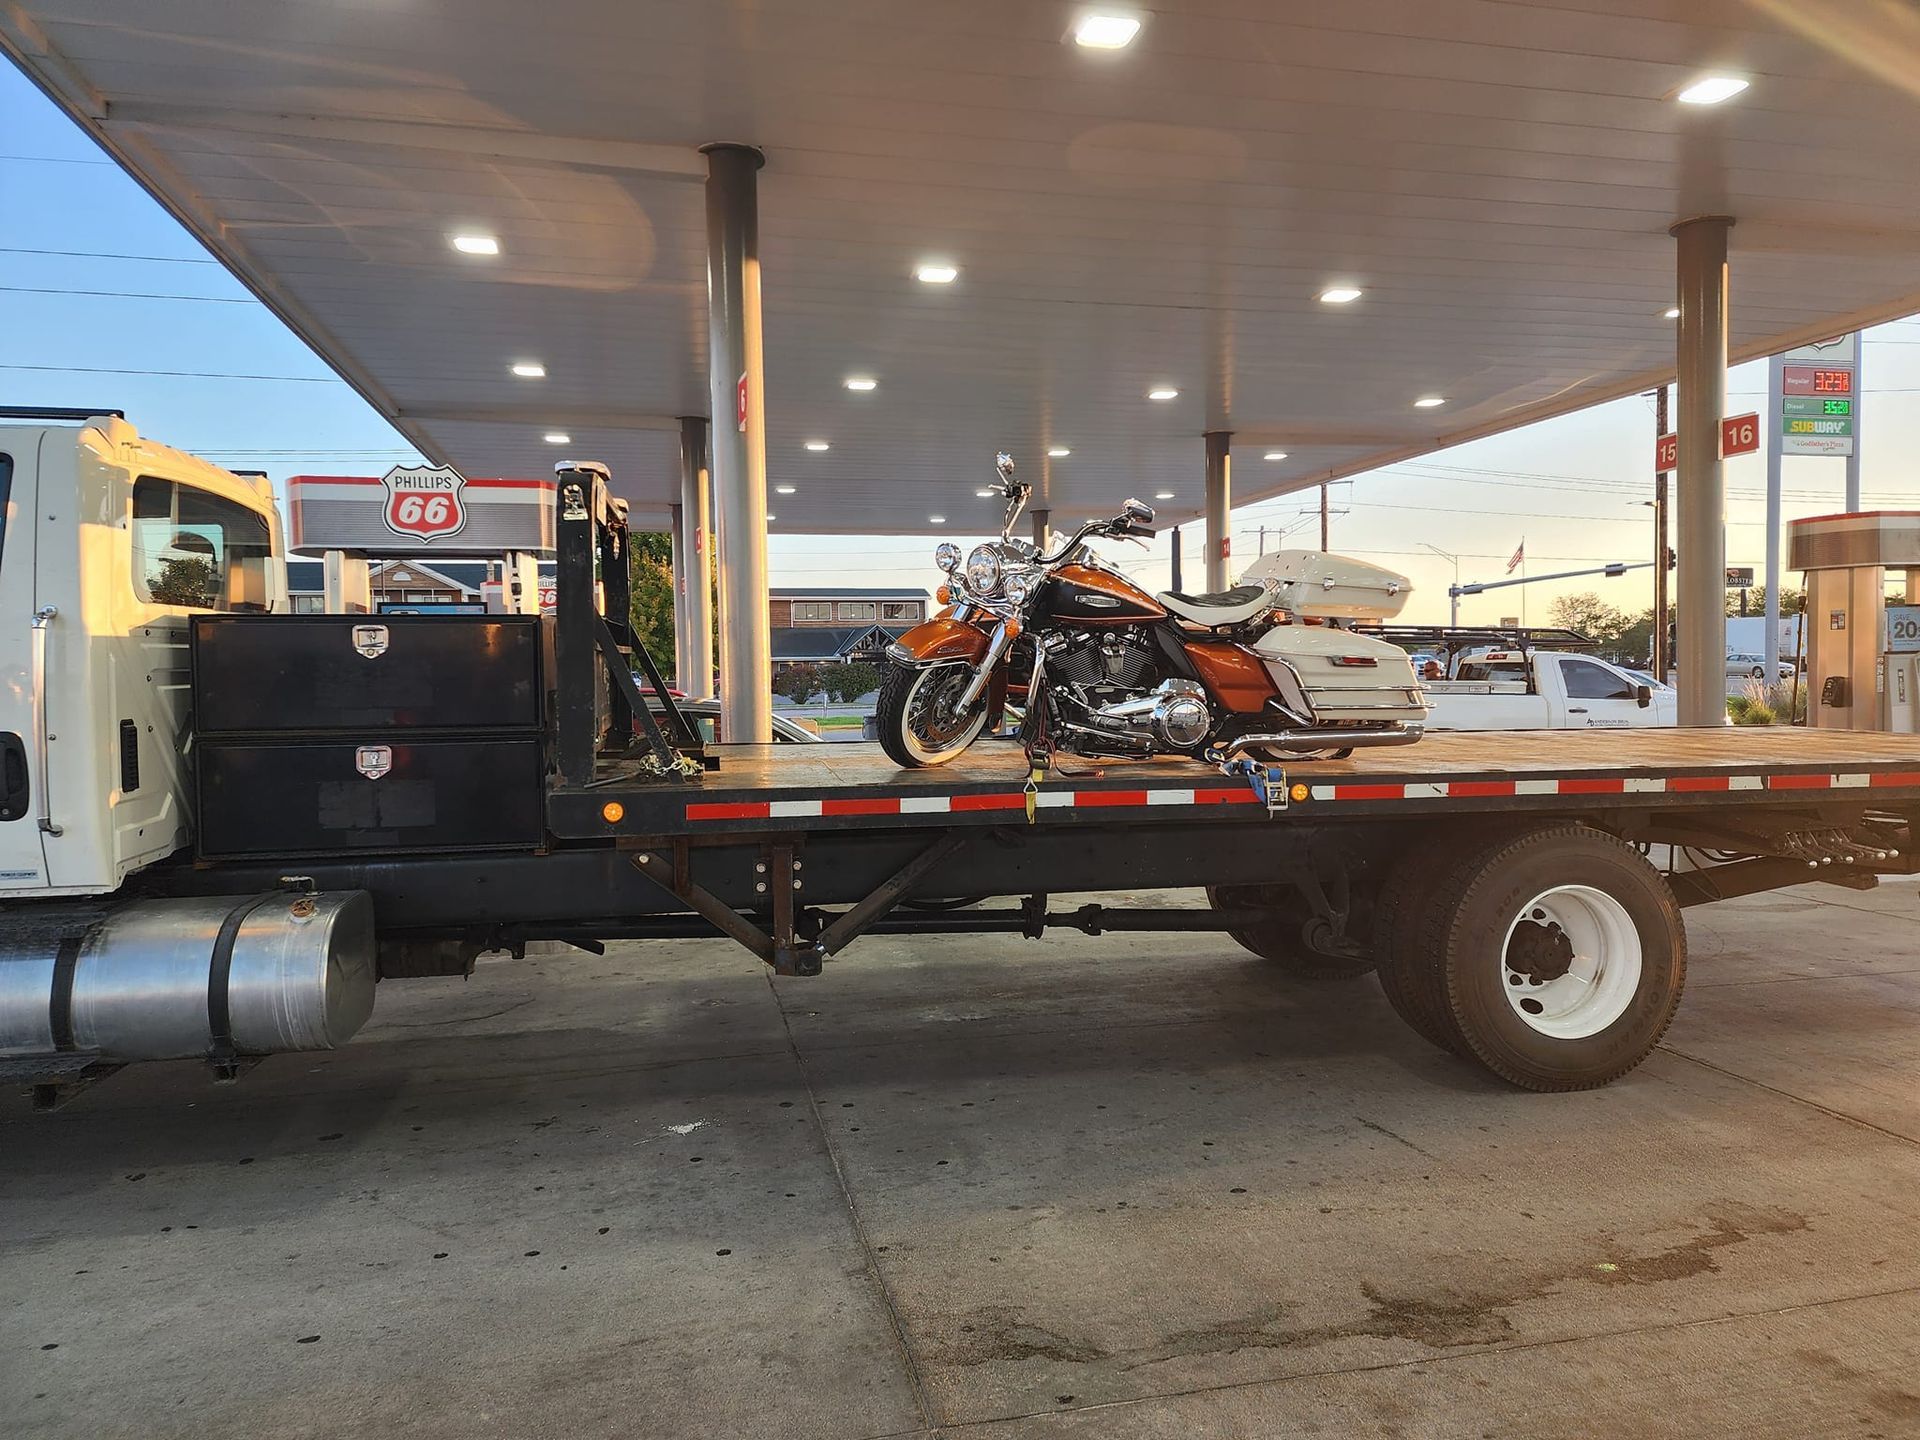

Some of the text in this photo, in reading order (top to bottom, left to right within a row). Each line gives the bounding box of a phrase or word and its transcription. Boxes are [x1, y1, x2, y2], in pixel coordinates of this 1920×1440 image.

[1790, 420, 1844, 433] SUBWAY
[1728, 424, 1753, 446] 16
[1660, 443, 1676, 463] 15
[395, 476, 452, 489] PHILLIPS
[398, 496, 450, 524] 66
[1726, 576, 1753, 585] LOBSTER
[1894, 613, 1911, 621] SAVE
[1894, 621, 1920, 639] 20
